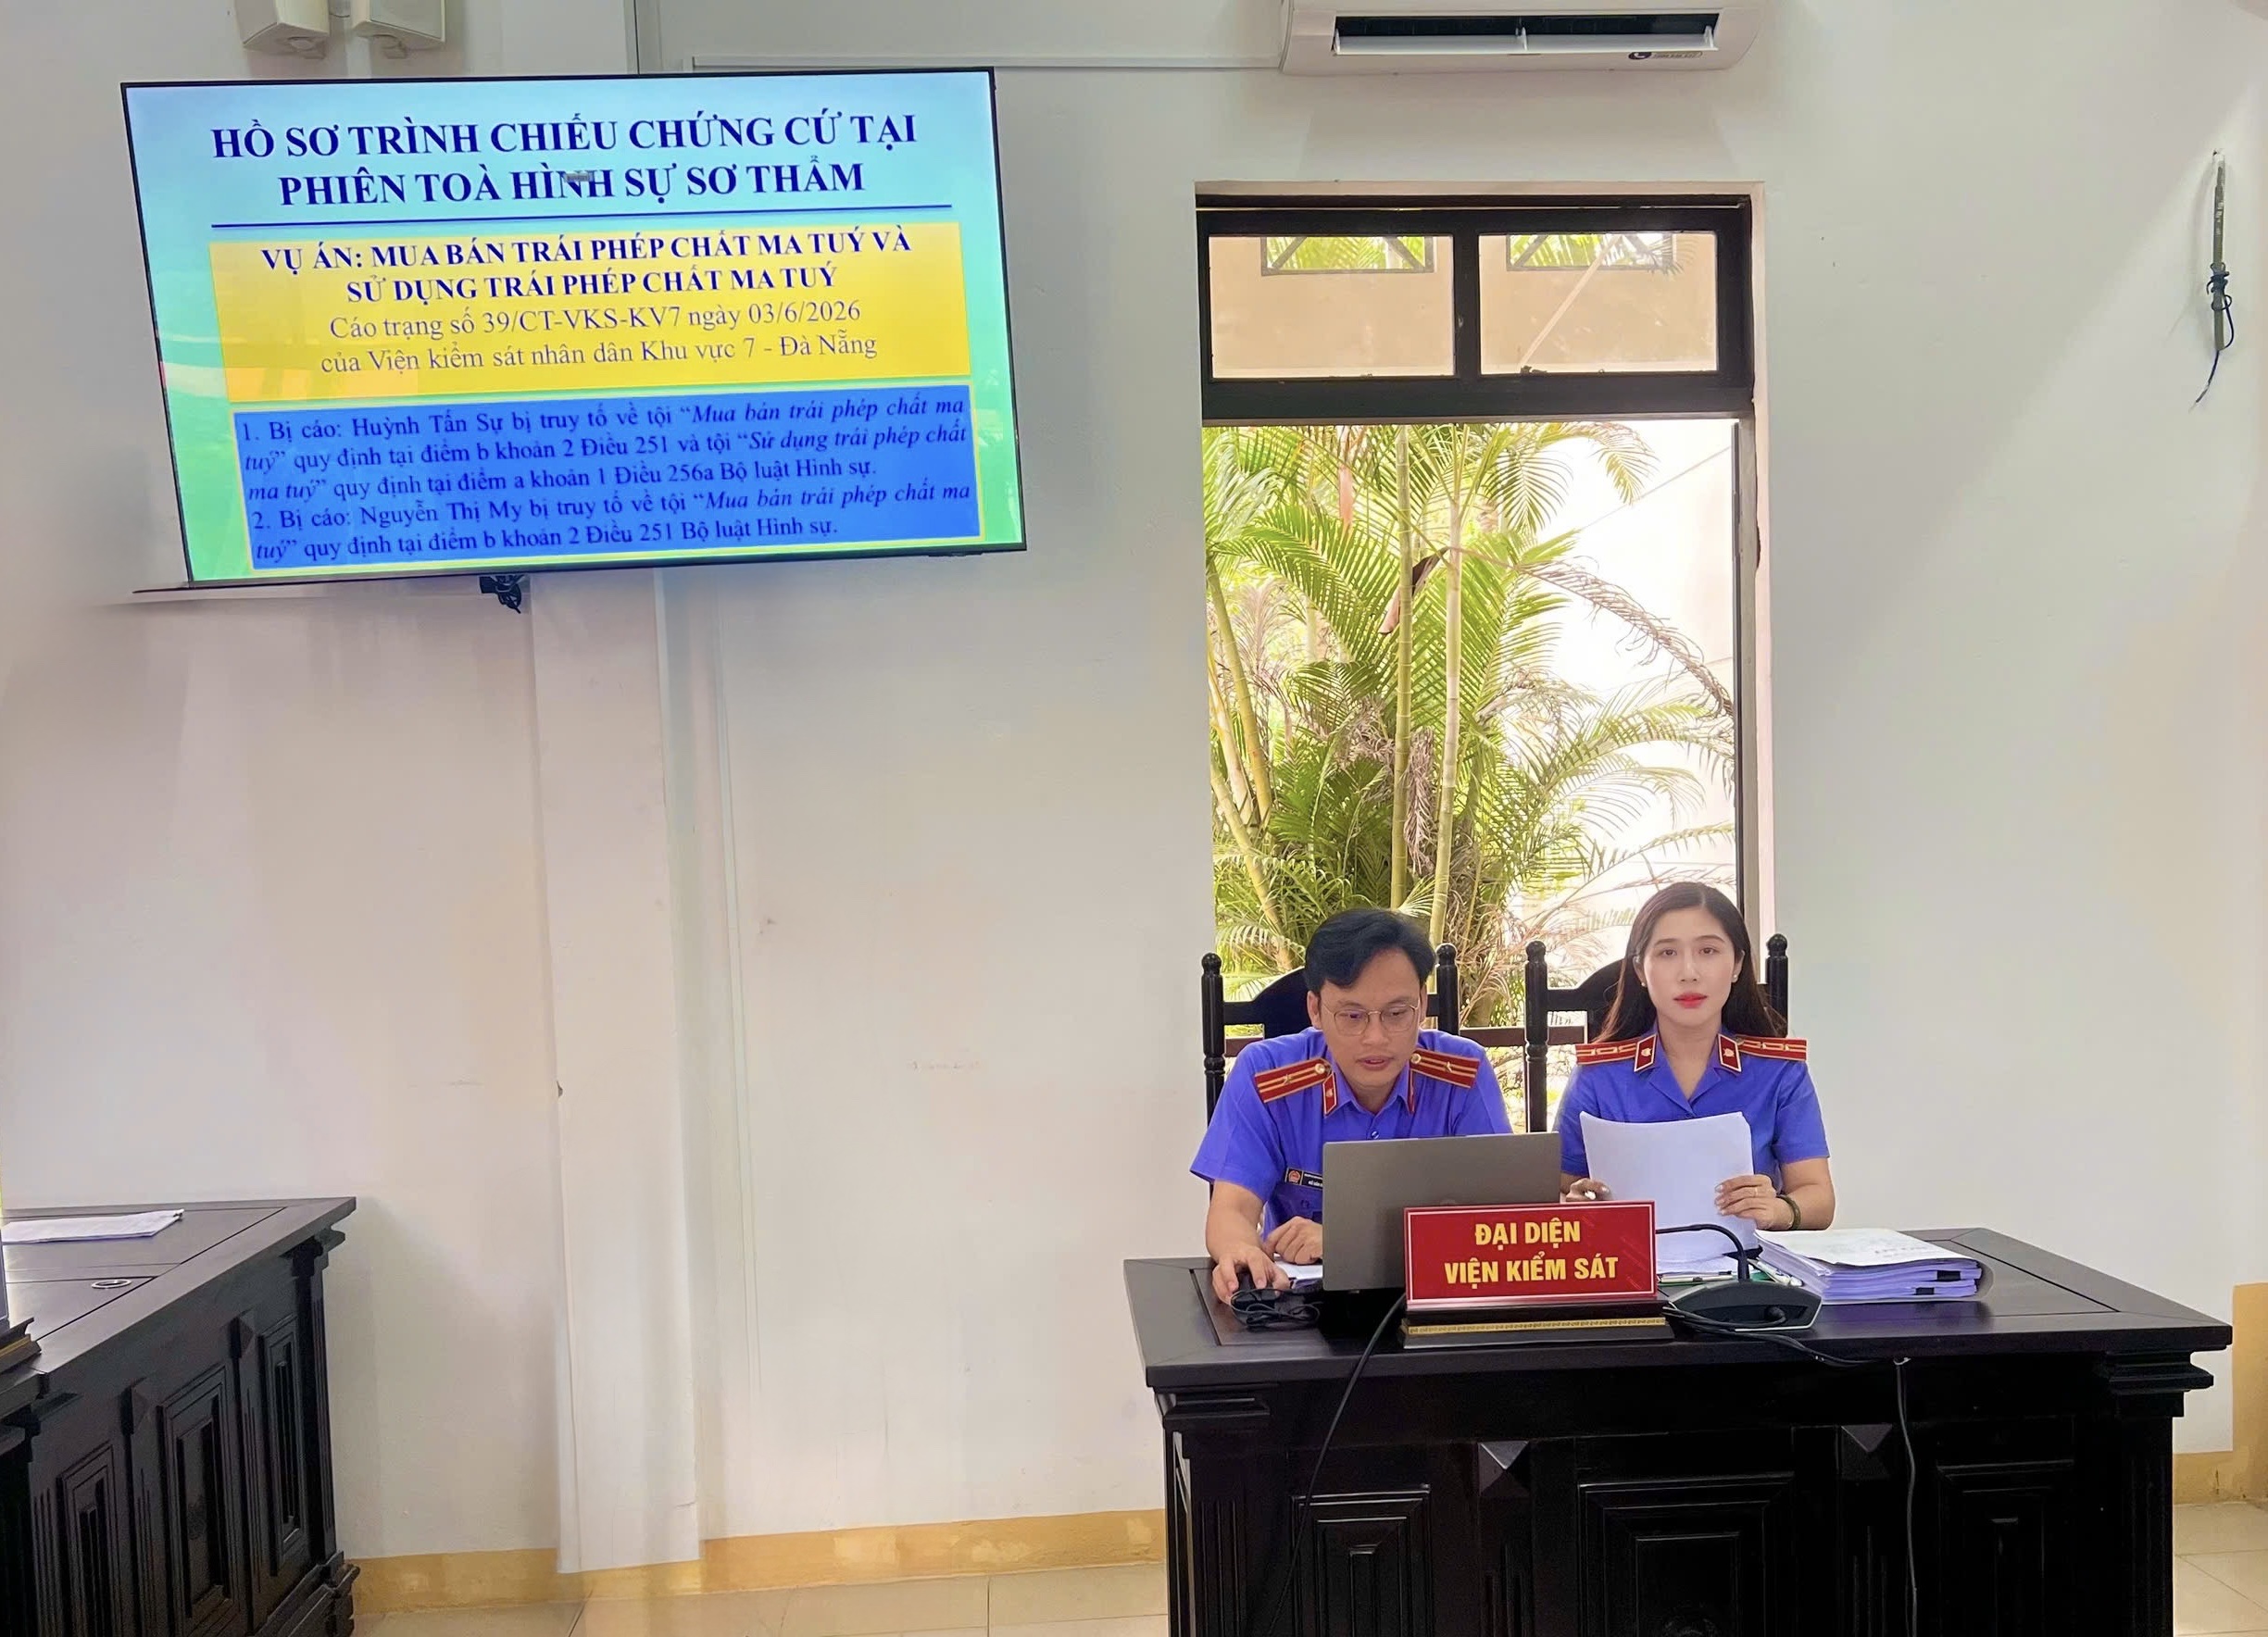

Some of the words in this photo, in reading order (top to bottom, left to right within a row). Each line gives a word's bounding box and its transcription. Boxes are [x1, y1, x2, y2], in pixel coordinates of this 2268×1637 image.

[211, 119, 274, 157] HỒ
[286, 124, 339, 157] SƠ
[348, 117, 479, 155] TRÌNH
[491, 113, 618, 151] CHIẾU
[629, 110, 774, 149] CHỨNG
[784, 107, 843, 145] CỨ
[850, 114, 917, 151] TẠI
[279, 166, 406, 206] PHIÊN
[415, 164, 500, 202] TOÀ
[509, 162, 615, 199] HÌNH
[624, 163, 677, 204] SỰ
[686, 164, 738, 195] SƠ
[746, 155, 866, 194] THẨM
[261, 248, 303, 275] VỤ
[313, 241, 362, 269] ÁN:
[371, 244, 440, 267] MUA
[445, 237, 505, 265] BÁN
[511, 234, 583, 263] TRÁI
[591, 231, 665, 260] PHÉP
[670, 230, 751, 258] CHẤT
[758, 235, 807, 255] MA
[808, 226, 866, 254] TUÝ
[871, 224, 912, 252] VÀ
[346, 275, 387, 303] SỬ
[394, 277, 476, 306] DỤNG
[483, 269, 556, 298] TRÁI
[562, 267, 637, 295] PHÉP
[642, 264, 722, 293] CHẤT
[731, 269, 776, 290] MA
[780, 261, 838, 288] TUÝ
[330, 316, 377, 339] Cáo
[382, 318, 445, 341] trạng
[450, 306, 475, 334] số
[482, 306, 681, 333] 39/CT-VKS-KV7
[687, 305, 742, 331] ngày
[748, 299, 861, 324] 03/6/2026
[320, 351, 361, 373] của
[368, 349, 420, 375] Viện
[427, 341, 484, 369] kiểm
[492, 345, 525, 368] sát
[531, 344, 584, 366] nhân
[594, 342, 633, 364] dân
[641, 340, 688, 361] Khu
[695, 343, 735, 363] vực
[743, 337, 755, 358] 7
[779, 335, 812, 356] Đà
[818, 329, 877, 358] Nẵng
[244, 422, 259, 441] 1.
[269, 421, 293, 443] Bị
[302, 422, 342, 439] cáo:
[352, 417, 420, 440] Huỳnh
[429, 408, 467, 433] Tấn
[476, 413, 504, 434] Sự
[512, 411, 531, 433] bị
[541, 414, 580, 432] truy
[588, 403, 608, 427] tố
[616, 402, 638, 425] về
[647, 406, 671, 428] tội
[680, 405, 736, 423] “Mua
[745, 401, 780, 421] bán
[789, 400, 823, 419] trái
[831, 398, 878, 422] phép
[886, 392, 927, 415] chất
[935, 400, 964, 414] ma
[294, 453, 331, 473] quy
[337, 446, 382, 468] định
[389, 448, 414, 469] tại
[420, 438, 470, 463] điểm
[477, 442, 489, 460] b
[495, 441, 556, 459] khoản
[563, 439, 574, 456] 2
[581, 431, 628, 456] Điều
[635, 436, 668, 454] 251
[678, 433, 699, 452] và
[707, 432, 731, 455] tội
[780, 431, 828, 452] dụng
[834, 427, 868, 446] trái
[873, 426, 920, 449] phép
[926, 418, 967, 443] chất
[248, 486, 279, 501] ma
[333, 481, 370, 501] quy
[378, 475, 421, 496] định
[428, 477, 452, 496] tại
[457, 466, 507, 491] điểm
[514, 475, 524, 488] a
[530, 469, 590, 487] khoản
[598, 468, 606, 484] 1
[614, 460, 662, 483] Điều
[668, 465, 714, 481] 256a
[720, 461, 747, 483] Bộ
[755, 460, 790, 482] luật
[848, 461, 876, 478] sự.
[253, 511, 270, 530] 2.
[280, 510, 303, 531] Bị
[311, 508, 351, 527] cáo:
[359, 499, 439, 528] Nguyễn
[446, 502, 481, 522] Thị
[488, 500, 522, 522] My
[530, 499, 548, 519] bị
[557, 501, 596, 519] truy
[604, 490, 622, 514] tố
[632, 489, 655, 512] về
[661, 495, 686, 518] tội
[694, 491, 748, 509] “Mua
[757, 487, 793, 507] bán
[801, 486, 833, 506] trái
[841, 483, 887, 508] phép
[895, 477, 935, 502] chất
[943, 485, 970, 500] ma
[304, 540, 341, 561] quy
[347, 535, 391, 556] định
[398, 535, 422, 556] tại
[429, 526, 477, 551] điểm
[483, 531, 495, 548] b
[502, 528, 561, 547] khoản
[569, 526, 580, 545] 2
[586, 519, 633, 544] Điều
[639, 523, 672, 543] 251
[682, 521, 708, 545] Bộ
[715, 520, 750, 542] luật
[810, 520, 837, 537] sự.
[1474, 1222, 1517, 1250] ĐẠI
[1524, 1217, 1581, 1248] DIỆN
[1444, 1257, 1499, 1289] VIỆN
[1506, 1251, 1566, 1281] KIỂM
[1574, 1253, 1619, 1280] SÁT
